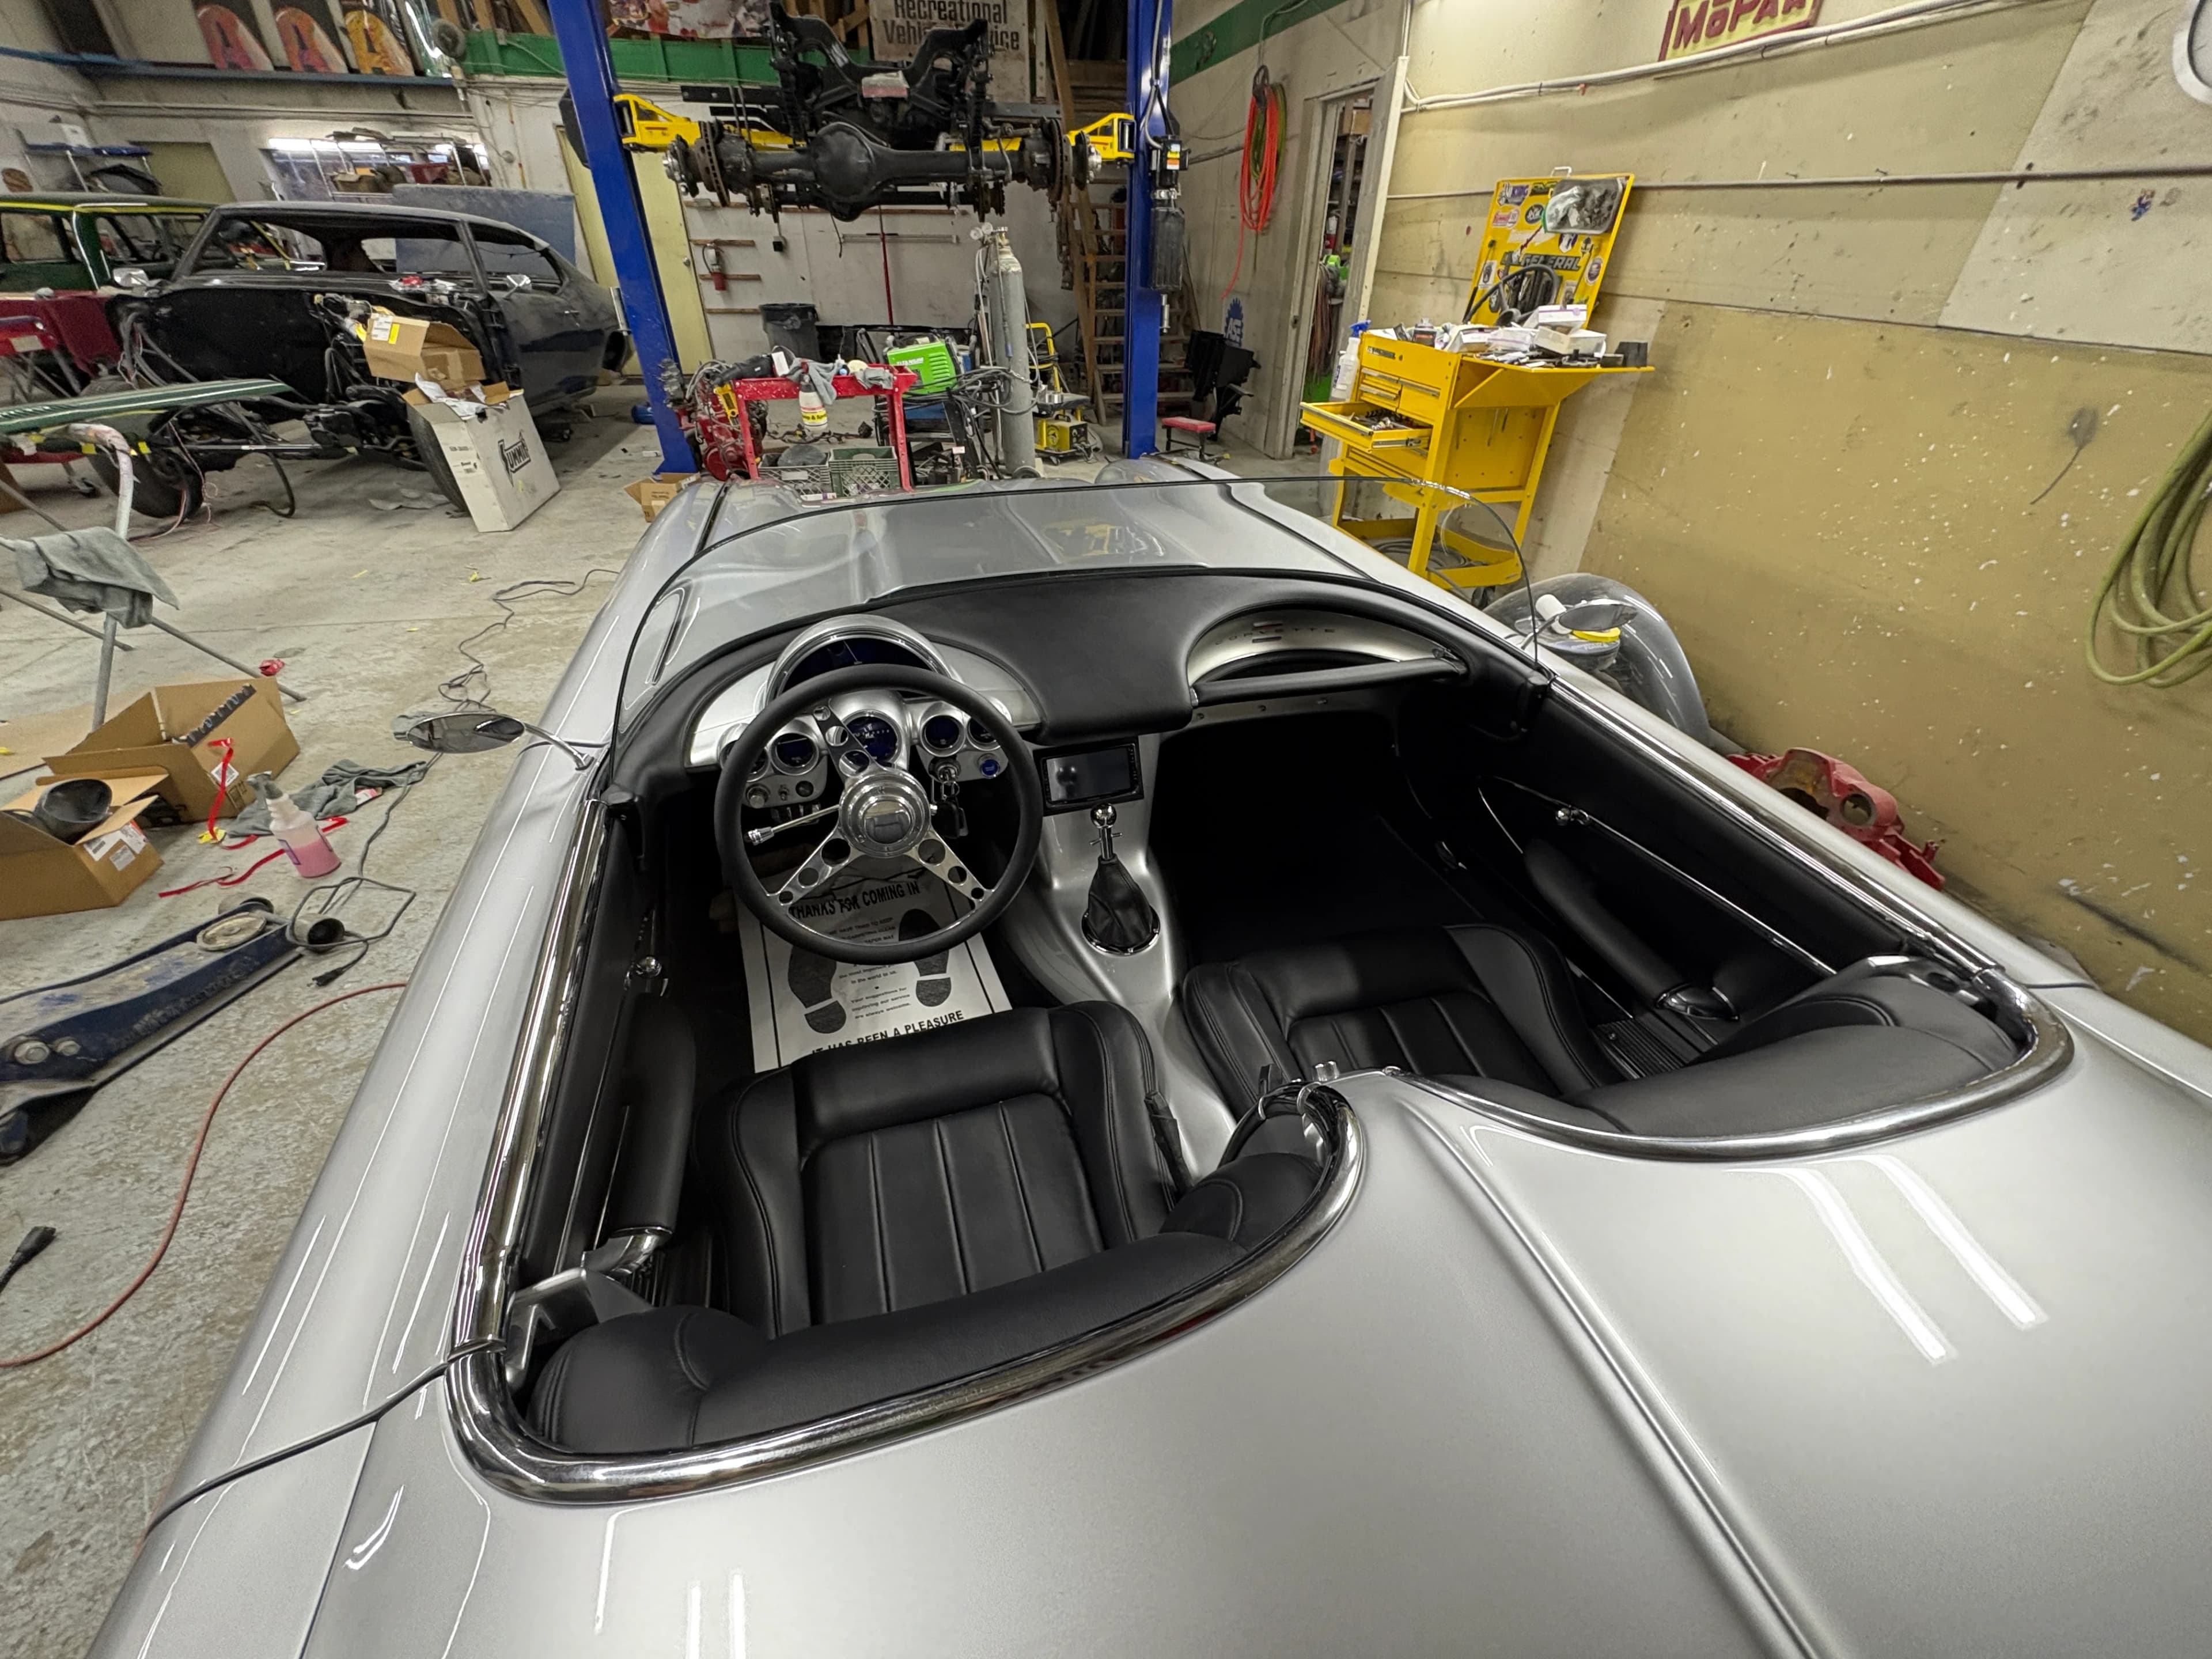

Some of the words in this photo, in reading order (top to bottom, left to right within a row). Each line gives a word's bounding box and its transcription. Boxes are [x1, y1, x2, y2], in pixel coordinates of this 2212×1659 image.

[895, 0, 1007, 24] Recreational
[789, 899, 835, 919] THANKS
[839, 895, 861, 913] FOR
[862, 884, 905, 907] COMING
[908, 881, 920, 895] IN
[891, 994, 910, 1002] service
[865, 1009, 884, 1017] always
[893, 1027, 902, 1037] A
[904, 1010, 964, 1034] PLEASURE
